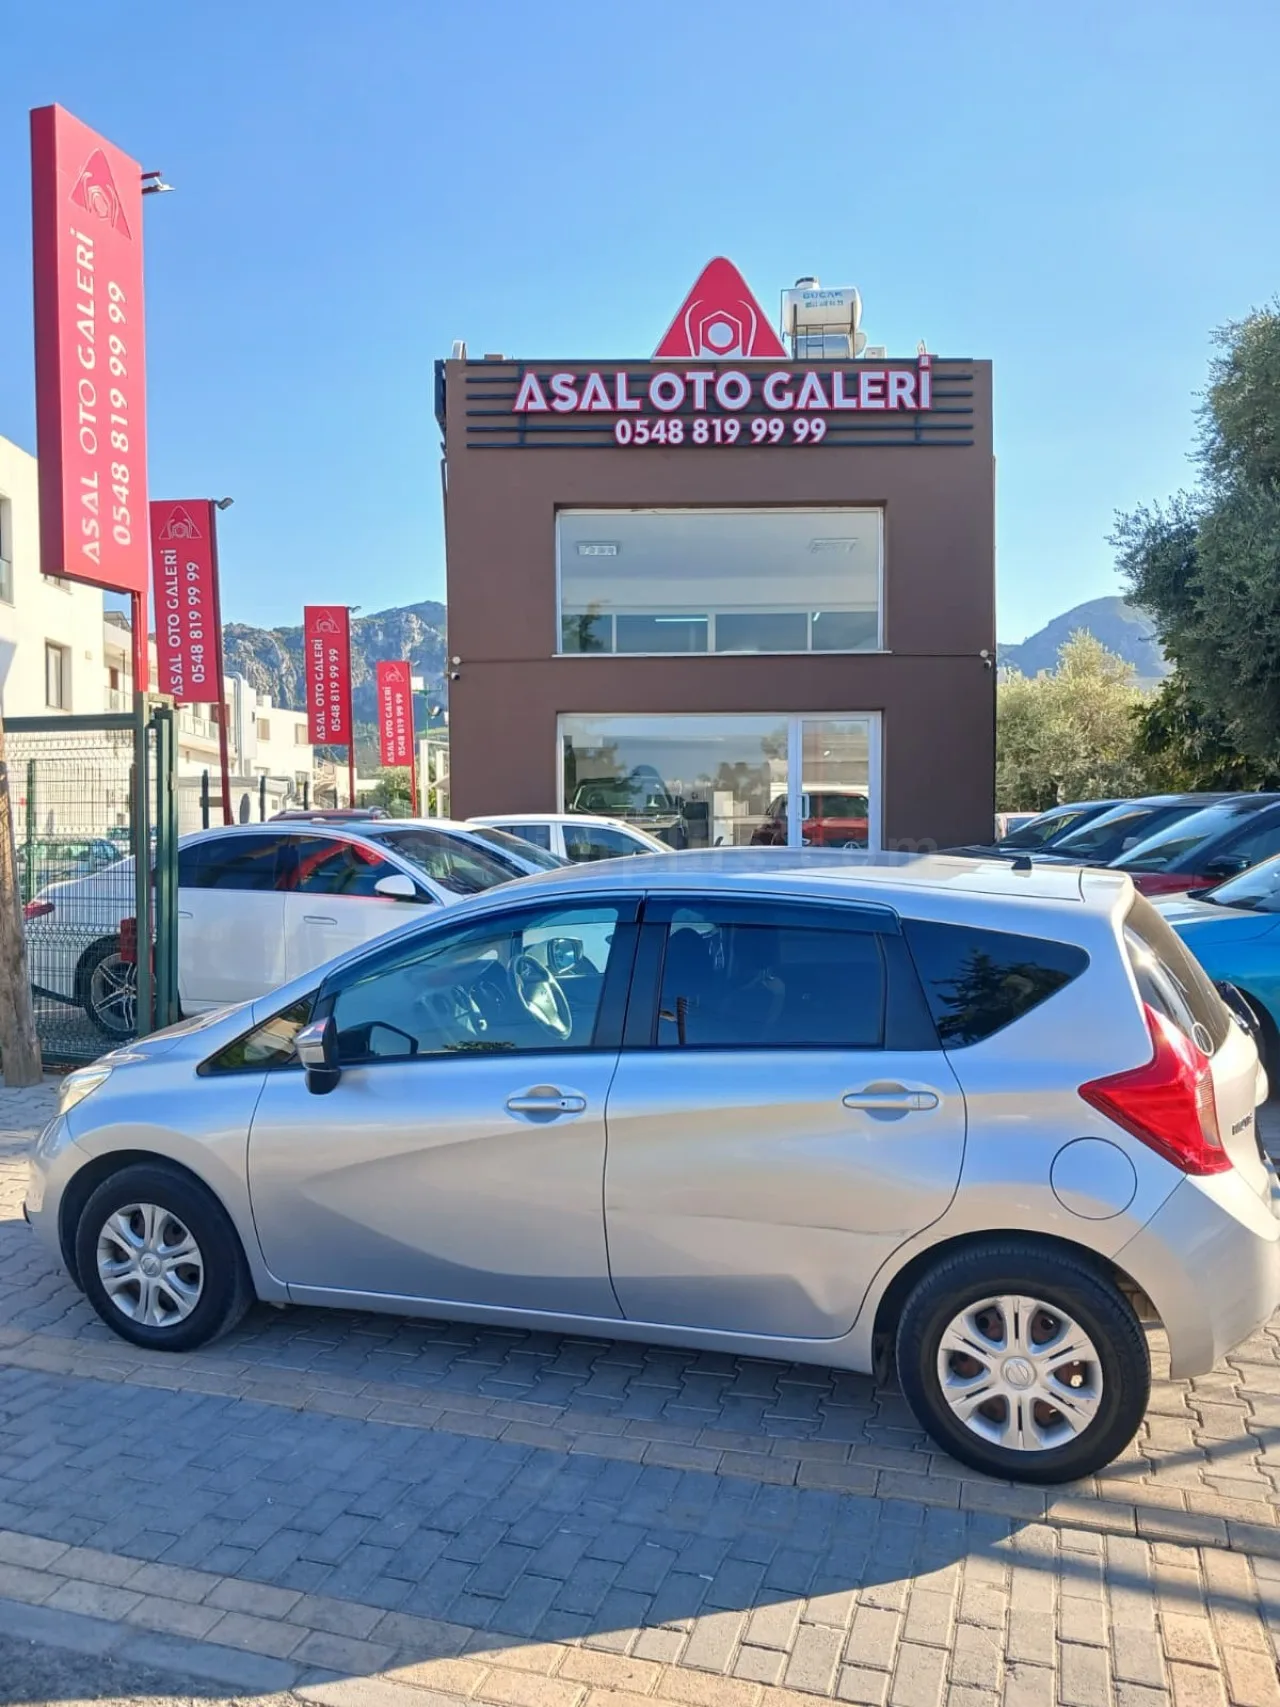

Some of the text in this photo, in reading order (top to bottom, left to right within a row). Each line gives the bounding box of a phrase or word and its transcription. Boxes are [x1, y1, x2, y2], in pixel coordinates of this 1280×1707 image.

[69, 229, 100, 565] ASAL OTO GALERİ
[107, 280, 132, 546] 0548 819 99 99
[512, 354, 933, 412] ASAL OTO GALERİ
[614, 418, 827, 445] 0548 819 99 99
[160, 549, 183, 696] ASAL OTO GALERİ
[186, 561, 206, 683] 0548 819 99 99
[311, 639, 325, 740] ASAL OTO GALERİ
[328, 648, 340, 731] 0548 819 99 99
